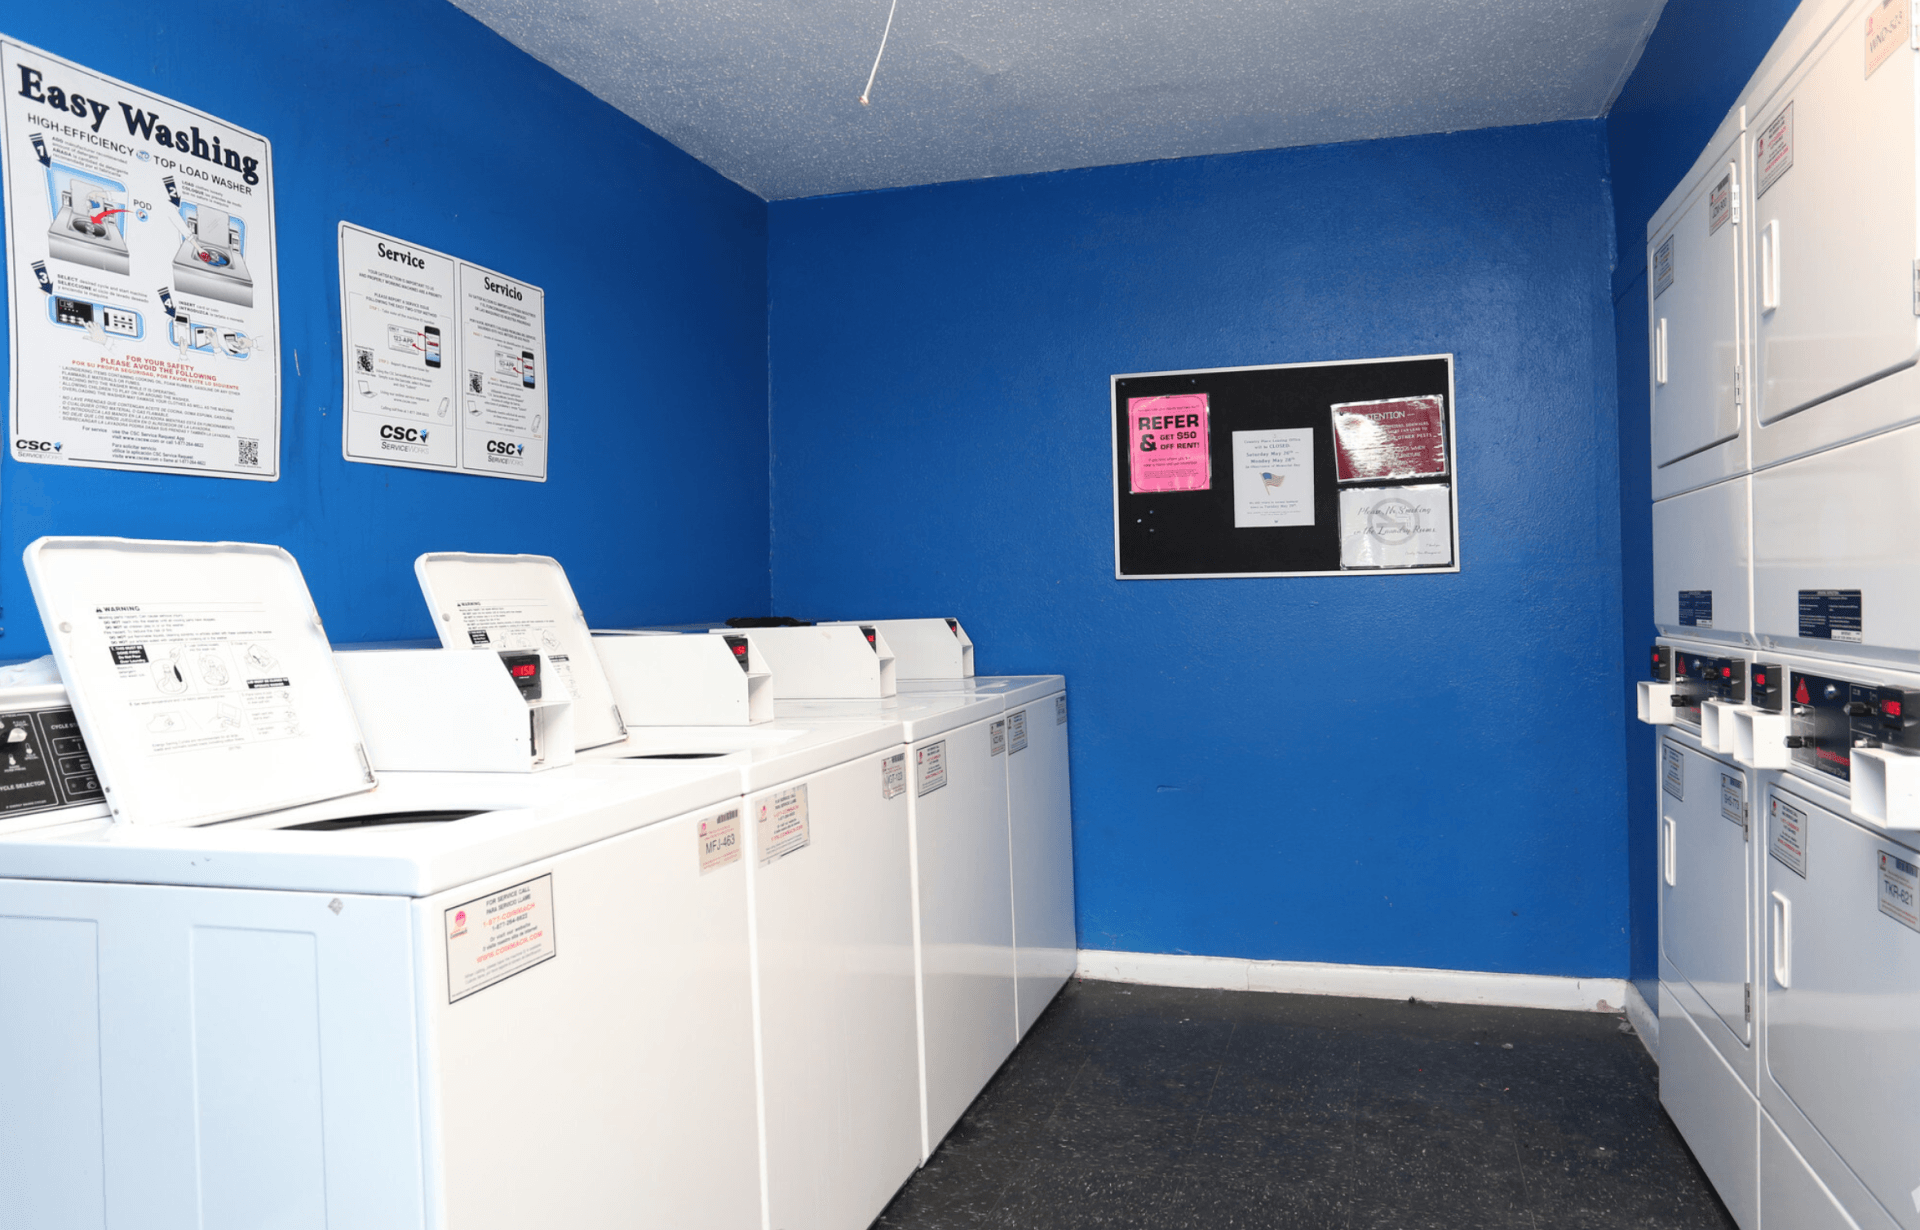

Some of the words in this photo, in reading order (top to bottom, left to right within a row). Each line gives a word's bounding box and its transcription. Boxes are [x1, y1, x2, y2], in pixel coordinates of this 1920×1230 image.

[17, 63, 110, 132] Easy
[118, 101, 259, 185] Washing
[27, 113, 134, 156] HIGH-EFFICIENCY
[153, 155, 176, 169] TOP
[179, 163, 209, 180] LOAD
[211, 174, 252, 196] WASHER
[133, 199, 152, 211] POD
[378, 242, 425, 270] Service
[39, 272, 49, 284] 3
[484, 277, 522, 301] Servicio
[164, 299, 172, 308] 4
[100, 357, 130, 367] PLEASE
[133, 363, 156, 372] AVOID
[159, 367, 173, 375] THE
[176, 370, 217, 381] FOLLOWING
[167, 362, 194, 371] SAFETY
[1139, 414, 1199, 431] REFER
[380, 424, 418, 441] CSC
[16, 439, 51, 451] CSC
[487, 440, 516, 455] CSC
[1140, 434, 1157, 452] &
[1385, 506, 1396, 515] No
[1398, 505, 1431, 514] Smoking
[16, 780, 45, 788] SELECTOR
[706, 833, 735, 854] MFJ-463
[486, 898, 496, 906] FOR
[498, 892, 517, 902] SERVICE
[518, 886, 530, 894] CALL
[1884, 880, 1913, 907] TKR-621
